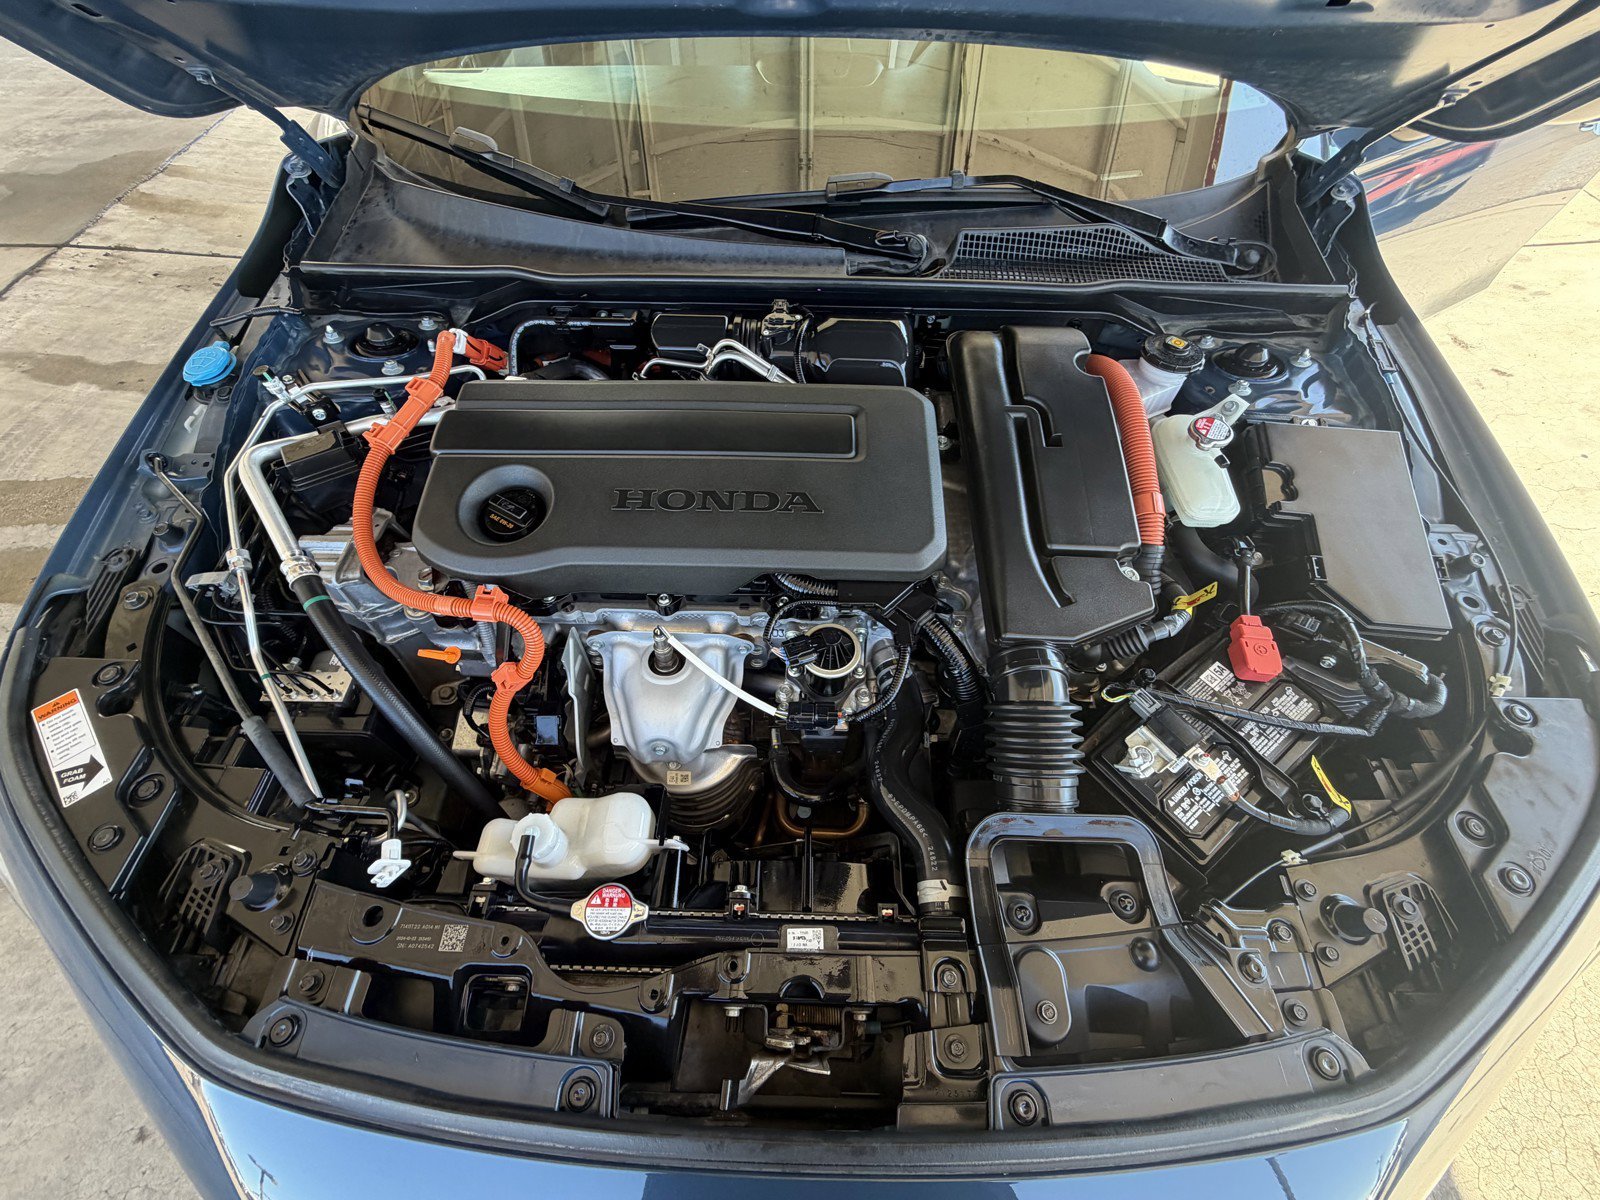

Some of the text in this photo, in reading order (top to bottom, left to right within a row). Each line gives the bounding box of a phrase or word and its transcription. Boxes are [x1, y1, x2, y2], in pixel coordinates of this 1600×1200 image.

[611, 487, 824, 514] HONDA
[1213, 664, 1227, 677] 5A
[38, 698, 77, 720] WARNING
[61, 767, 84, 779] GRAB
[62, 773, 87, 785] FOAM
